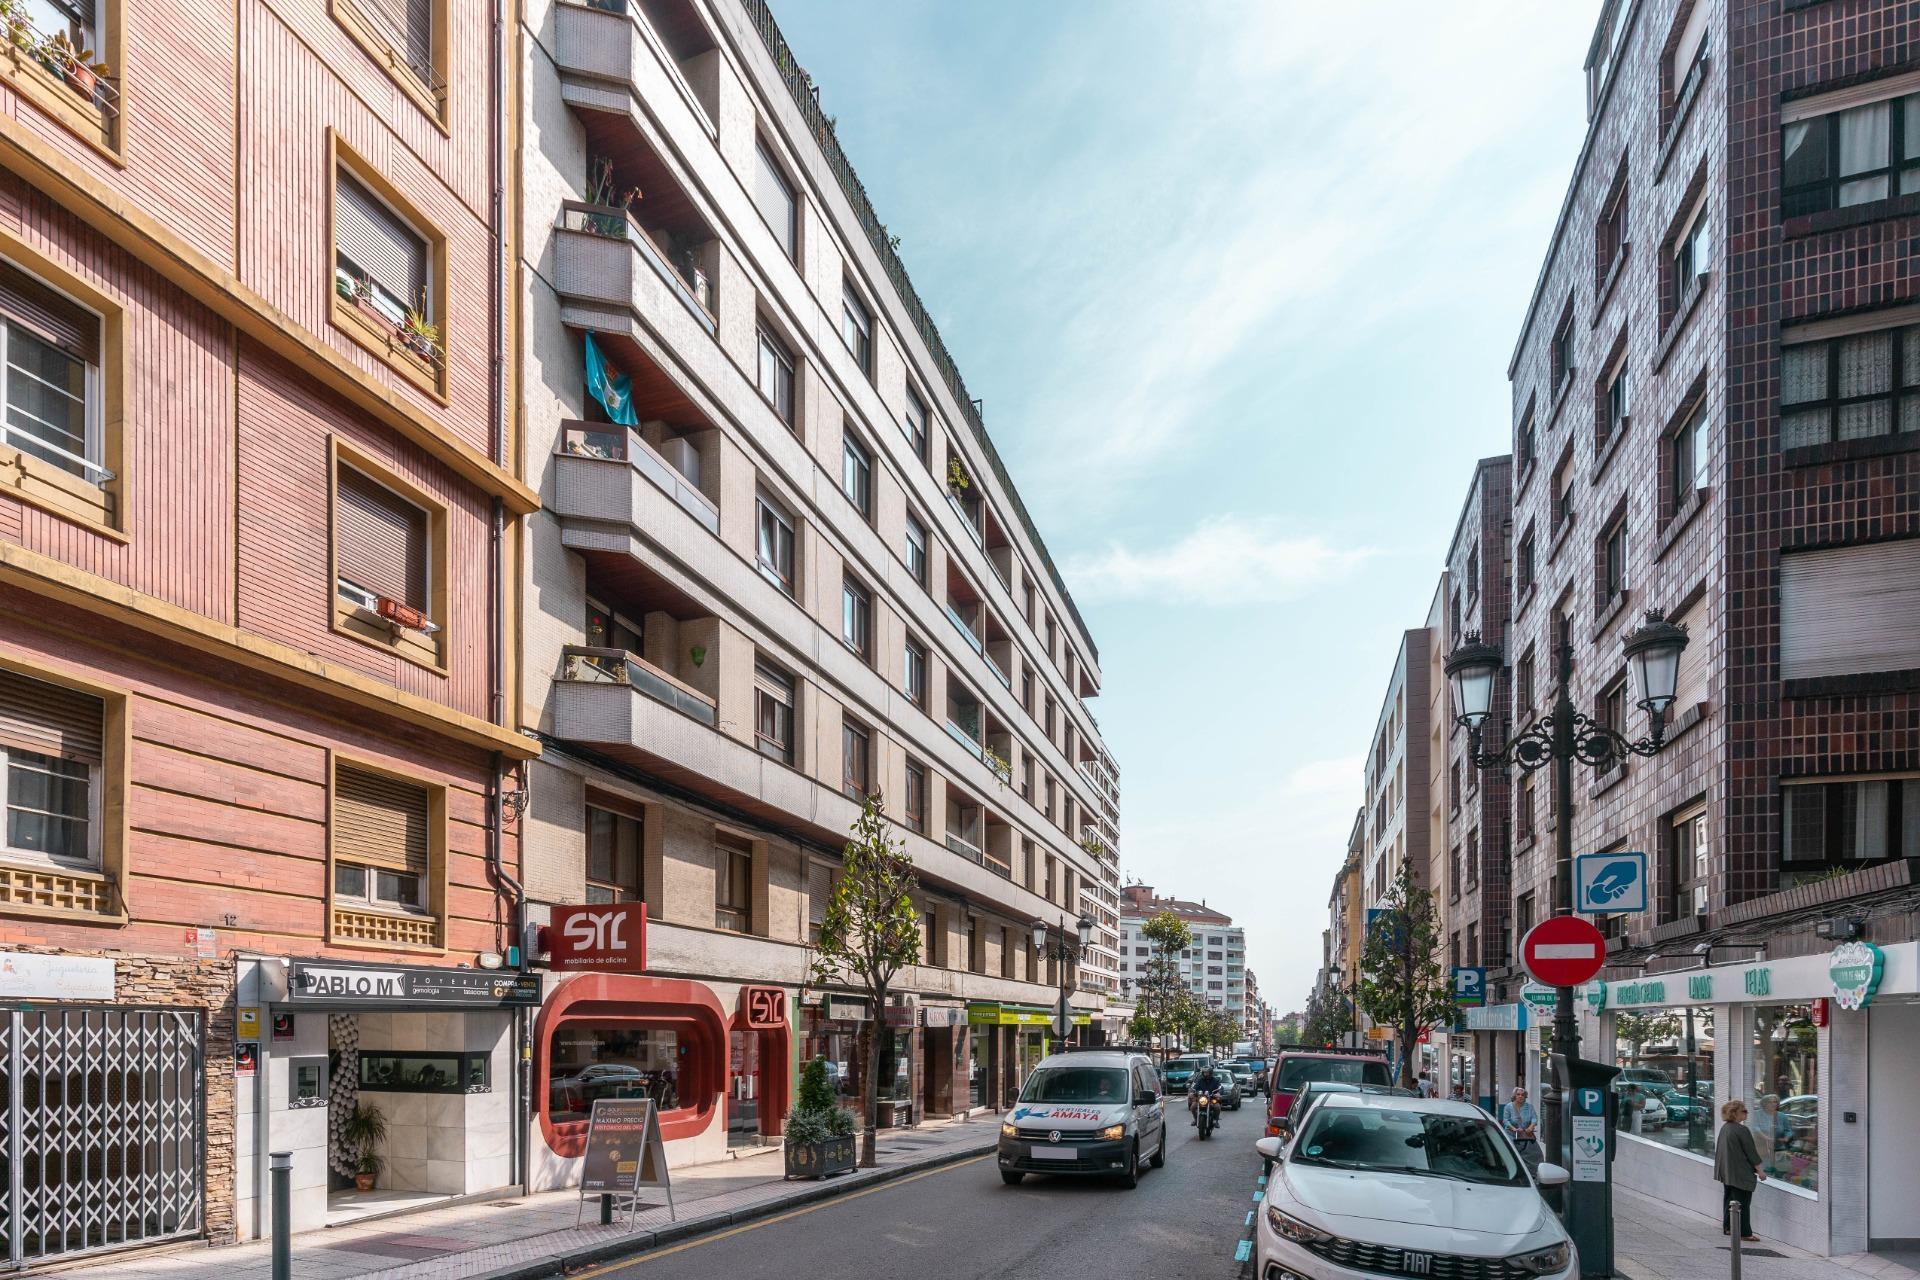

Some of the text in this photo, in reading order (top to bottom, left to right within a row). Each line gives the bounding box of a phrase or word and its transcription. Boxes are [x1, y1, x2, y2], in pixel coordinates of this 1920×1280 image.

[224, 913, 238, 927] 12
[564, 911, 627, 951] SYC
[309, 974, 394, 997] PABLO M
[1457, 969, 1480, 992] P
[1688, 975, 1713, 1001] LANAS
[1744, 967, 1771, 997] TELAS
[1585, 1090, 1600, 1110] P
[1051, 1111, 1099, 1120] AMAYA
[1403, 1251, 1432, 1274] FIAT
